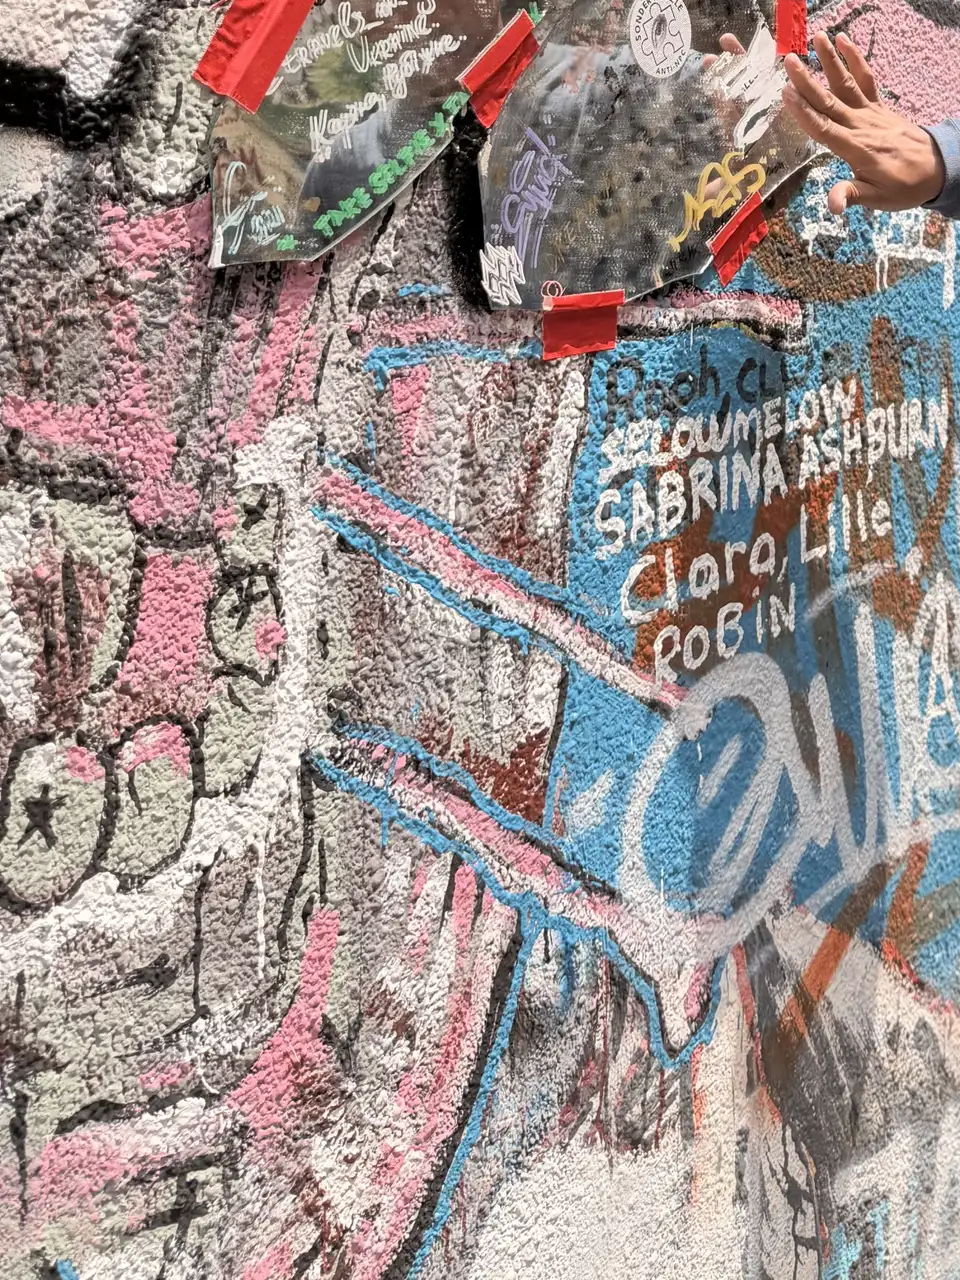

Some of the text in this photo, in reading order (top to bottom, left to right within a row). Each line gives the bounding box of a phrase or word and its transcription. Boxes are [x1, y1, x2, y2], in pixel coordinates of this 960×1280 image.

[313, 186, 373, 238] TAKE
[594, 442, 790, 560] SABRINA
[798, 385, 951, 491] ASHBURN
